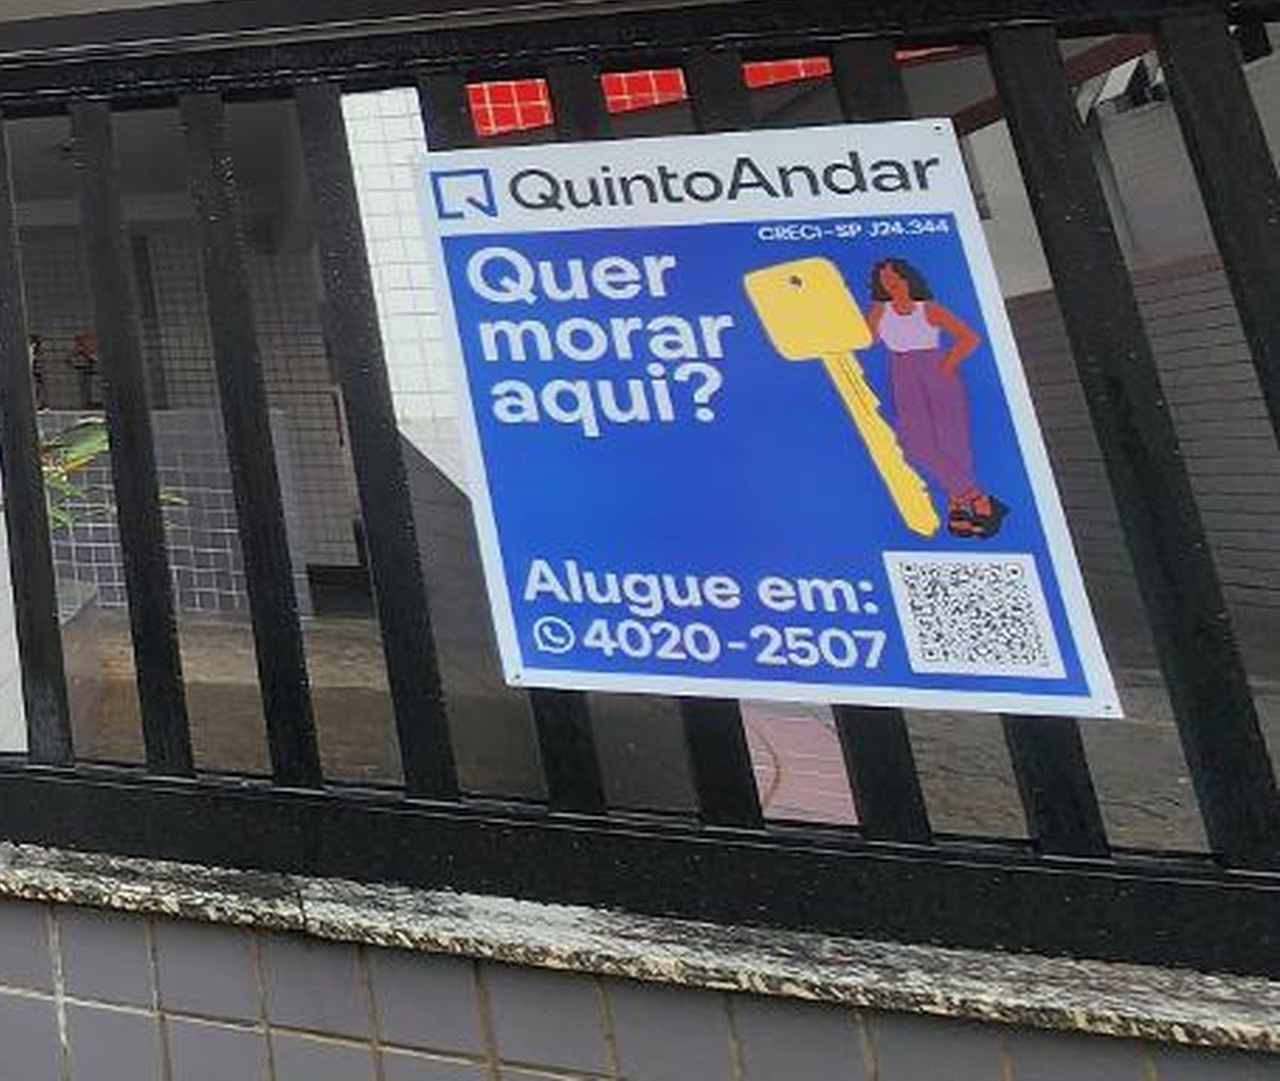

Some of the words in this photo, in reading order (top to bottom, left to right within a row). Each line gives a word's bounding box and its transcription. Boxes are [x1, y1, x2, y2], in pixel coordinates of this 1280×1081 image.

[509, 151, 941, 212] QuintoAndar
[466, 246, 676, 306] Quer
[479, 312, 735, 362] morar
[491, 362, 724, 438] aqui?
[523, 558, 741, 618] Alugue
[757, 574, 880, 615] em:
[583, 619, 888, 670] 4020-2507
